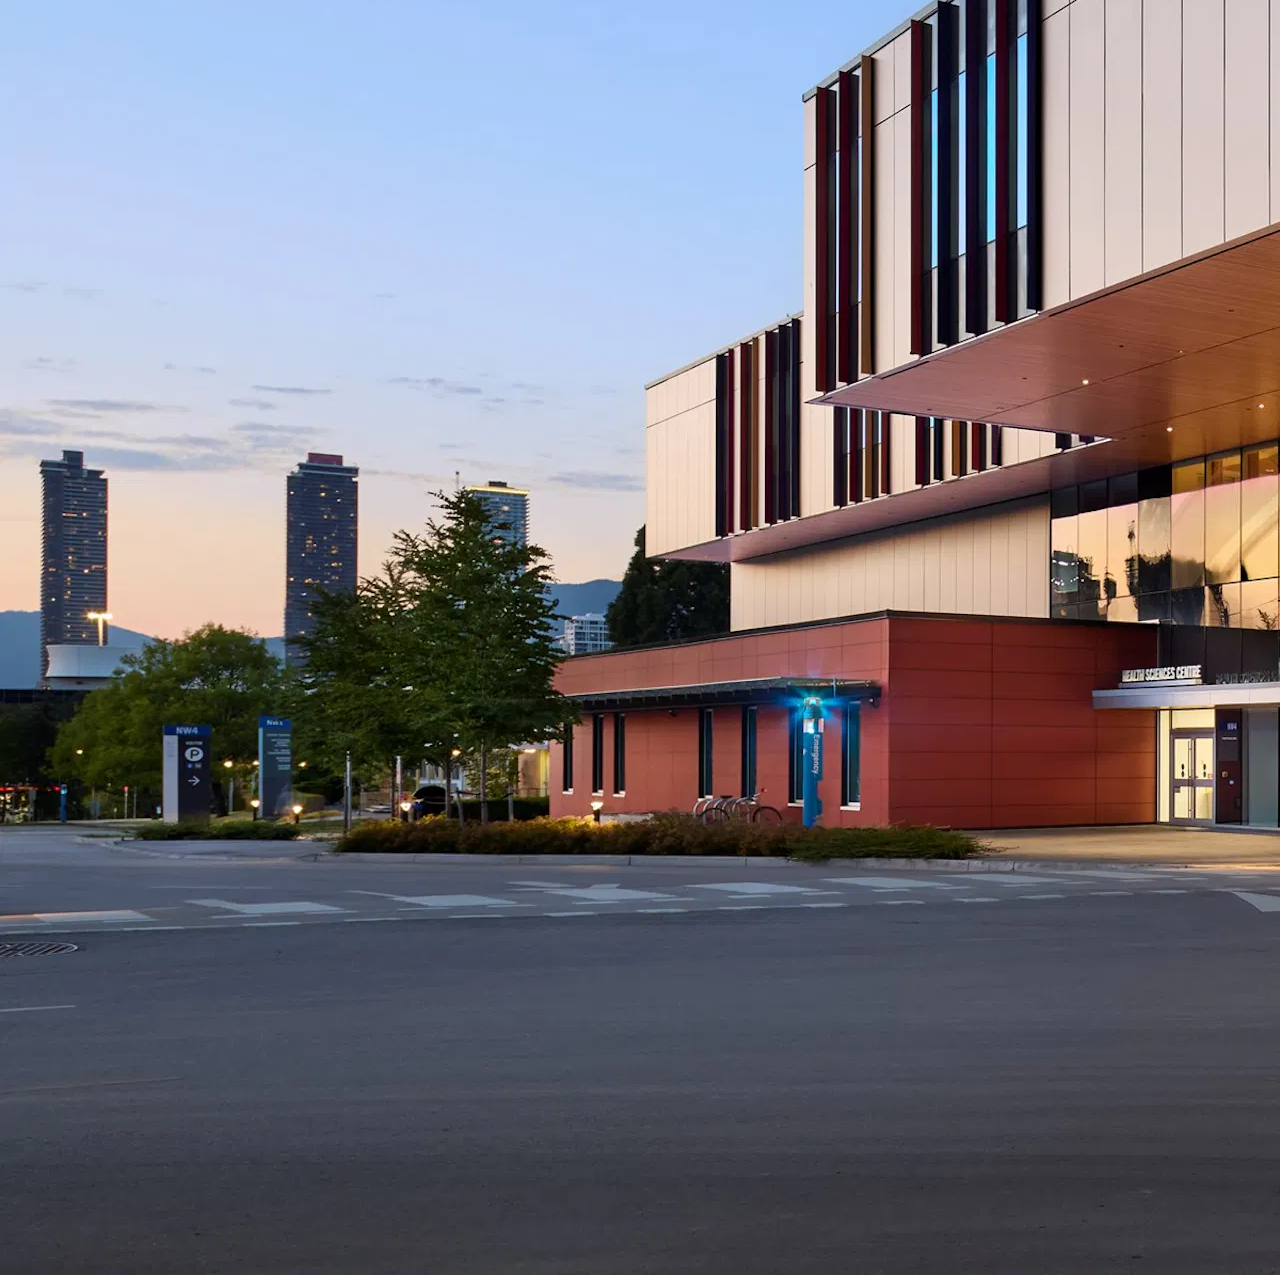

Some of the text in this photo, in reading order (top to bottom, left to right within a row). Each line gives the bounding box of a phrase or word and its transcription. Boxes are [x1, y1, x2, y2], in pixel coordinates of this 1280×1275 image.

[1121, 669, 1145, 683] HEALTH
[1145, 667, 1175, 681] SCIENCES
[1176, 665, 1202, 679] CENTRE
[176, 726, 199, 735] NW4
[190, 749, 200, 759] P
[811, 734, 821, 774] Emergency
